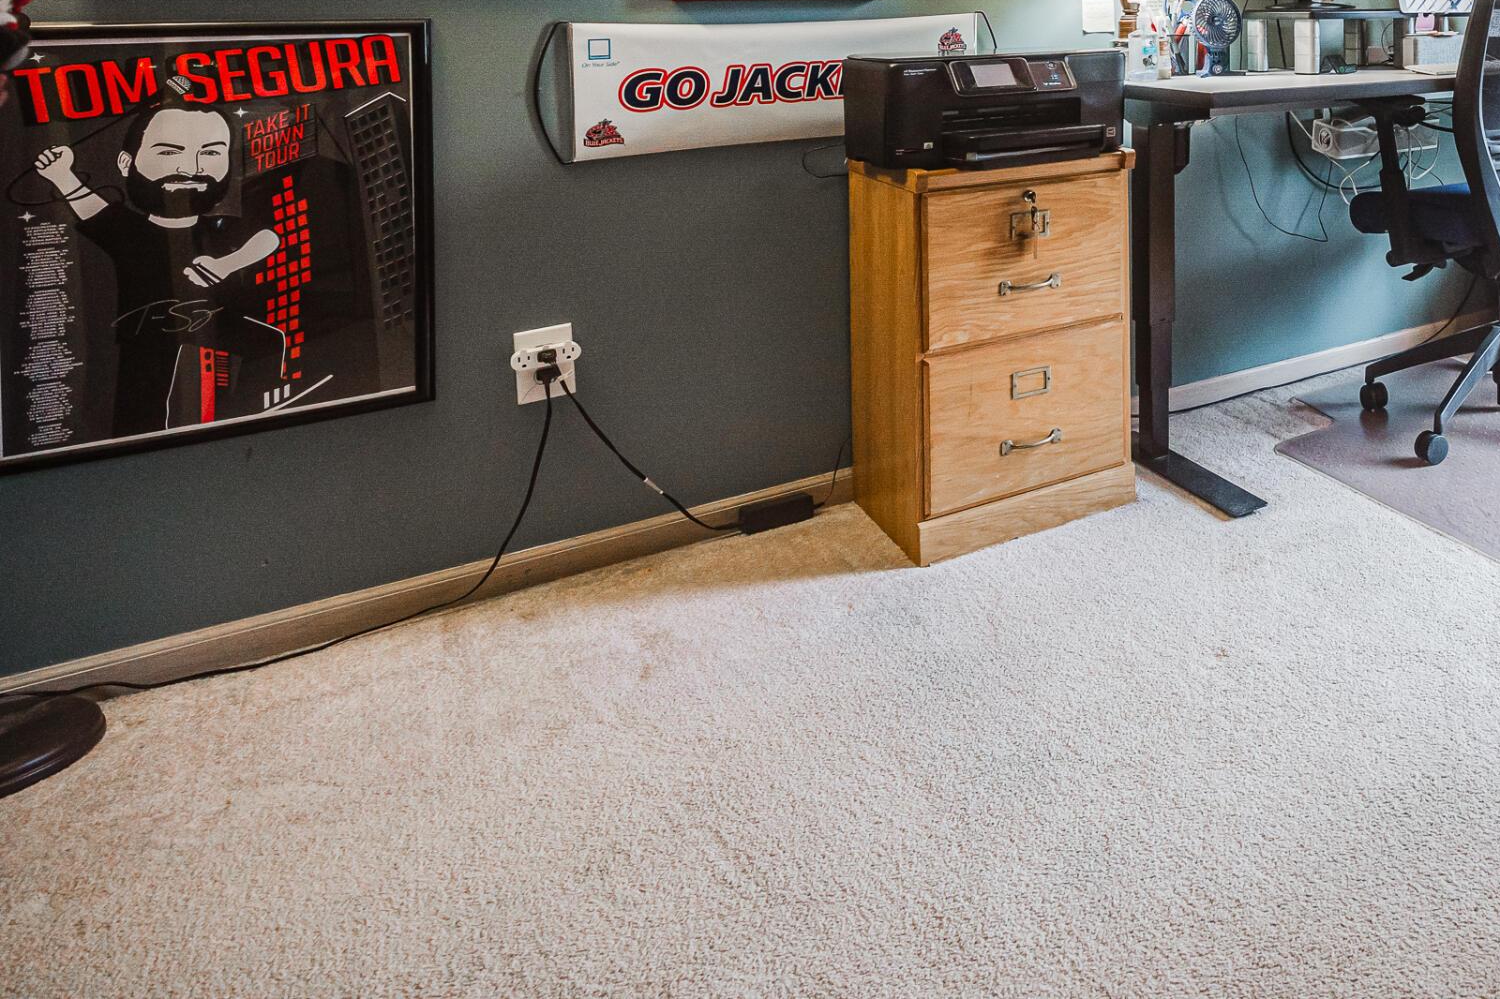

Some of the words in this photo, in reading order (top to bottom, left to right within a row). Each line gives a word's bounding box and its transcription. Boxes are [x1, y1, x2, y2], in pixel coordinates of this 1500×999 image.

[13, 57, 158, 124] TOM
[175, 34, 401, 105] SEGURA
[618, 66, 710, 112] GO
[711, 60, 843, 107] JACK
[244, 109, 289, 140] TAKE
[296, 103, 311, 123] IT
[251, 122, 304, 157] DOWN
[255, 141, 300, 173] TOUR
